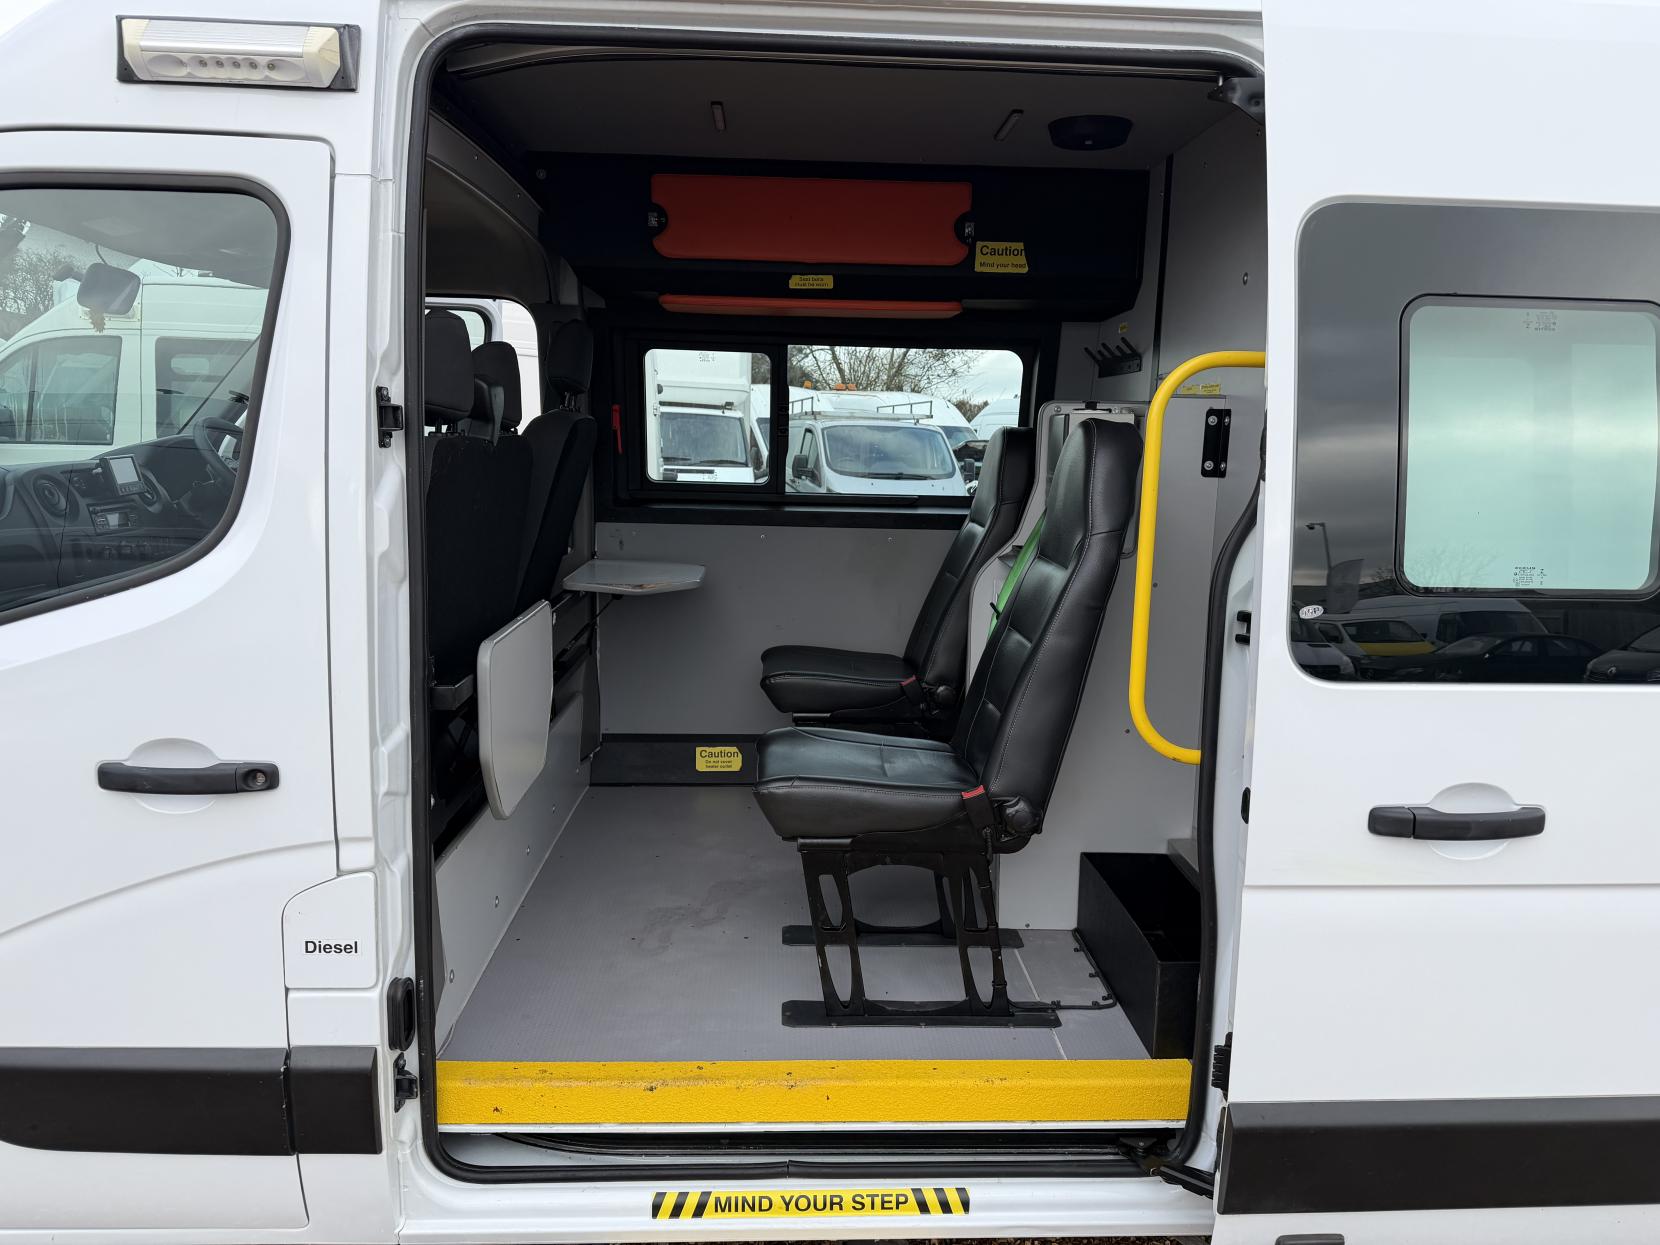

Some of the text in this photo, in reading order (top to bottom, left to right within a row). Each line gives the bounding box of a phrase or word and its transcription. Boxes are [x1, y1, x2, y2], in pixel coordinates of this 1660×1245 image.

[699, 749, 739, 758] Caution
[304, 940, 358, 954] Diesel
[714, 1193, 909, 1213] MIND YOUR STEP
